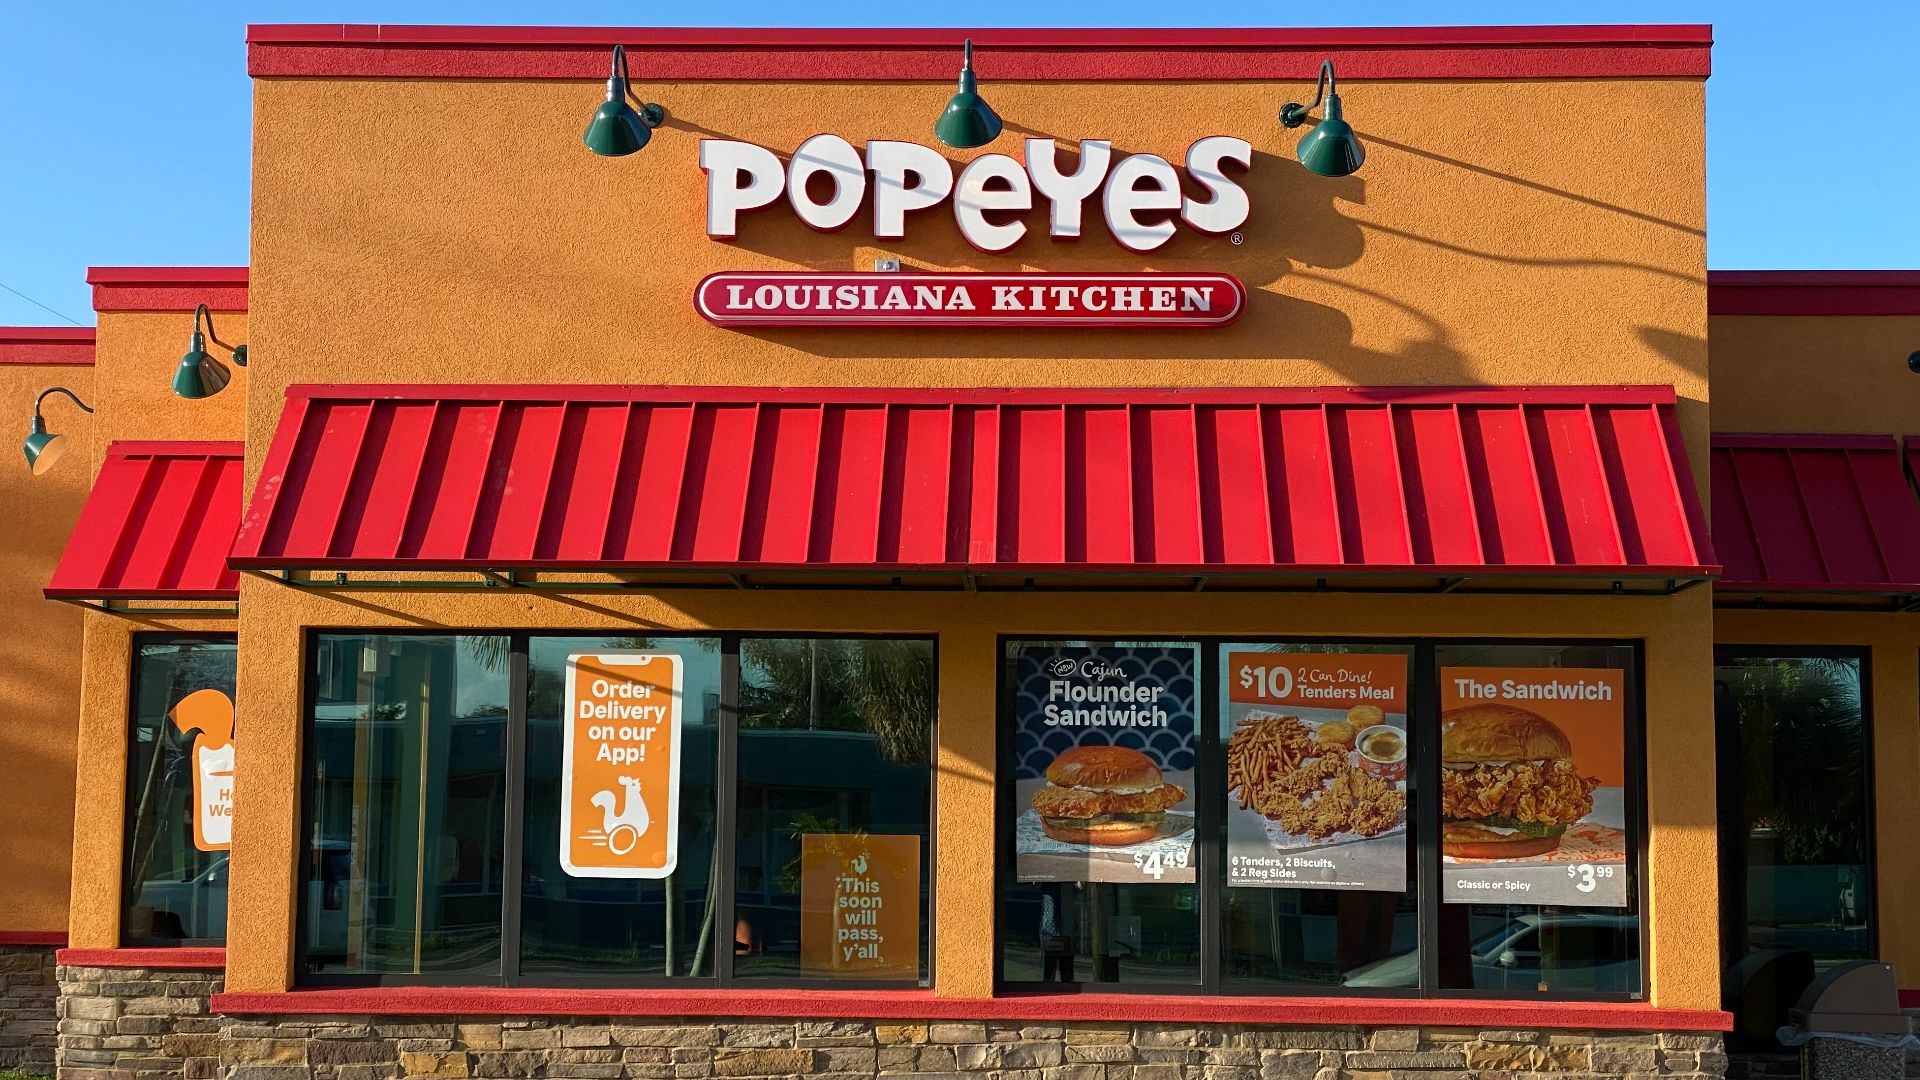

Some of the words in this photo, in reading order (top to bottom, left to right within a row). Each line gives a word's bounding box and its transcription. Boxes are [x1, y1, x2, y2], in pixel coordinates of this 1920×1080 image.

[726, 284, 975, 311] LOUISIANA
[991, 285, 1214, 312] KITCHEN
[1081, 661, 1127, 681] Cajun
[591, 679, 656, 699] Order
[1239, 665, 1293, 698] $10
[1297, 667, 1307, 682] 2
[1310, 669, 1335, 683] Can
[1337, 668, 1373, 684] Dine!
[1454, 678, 1497, 699] The
[1502, 679, 1612, 701] Sandwich
[1049, 680, 1164, 703] Flounder
[1297, 684, 1357, 699] Tenders
[1359, 685, 1394, 700] Meal
[579, 700, 666, 724] Delivery
[1043, 704, 1167, 727] Sandwich
[588, 725, 614, 741] on
[619, 726, 656, 741] our
[596, 743, 646, 765] App!
[1231, 856, 1239, 866] 6
[1240, 856, 1284, 868] Tenders,
[1285, 857, 1292, 867] 2
[1293, 857, 1336, 869] Biscuits,
[1231, 867, 1239, 877] &
[1240, 868, 1247, 877] 2
[1249, 868, 1268, 879] Reg
[1269, 868, 1297, 878] Sides
[842, 877, 880, 893] This
[1457, 879, 1491, 889] Classic
[1492, 881, 1503, 889] or
[1504, 880, 1531, 892] Spicy
[839, 896, 882, 908] soon
[845, 910, 877, 925] will
[838, 927, 884, 943] pass,
